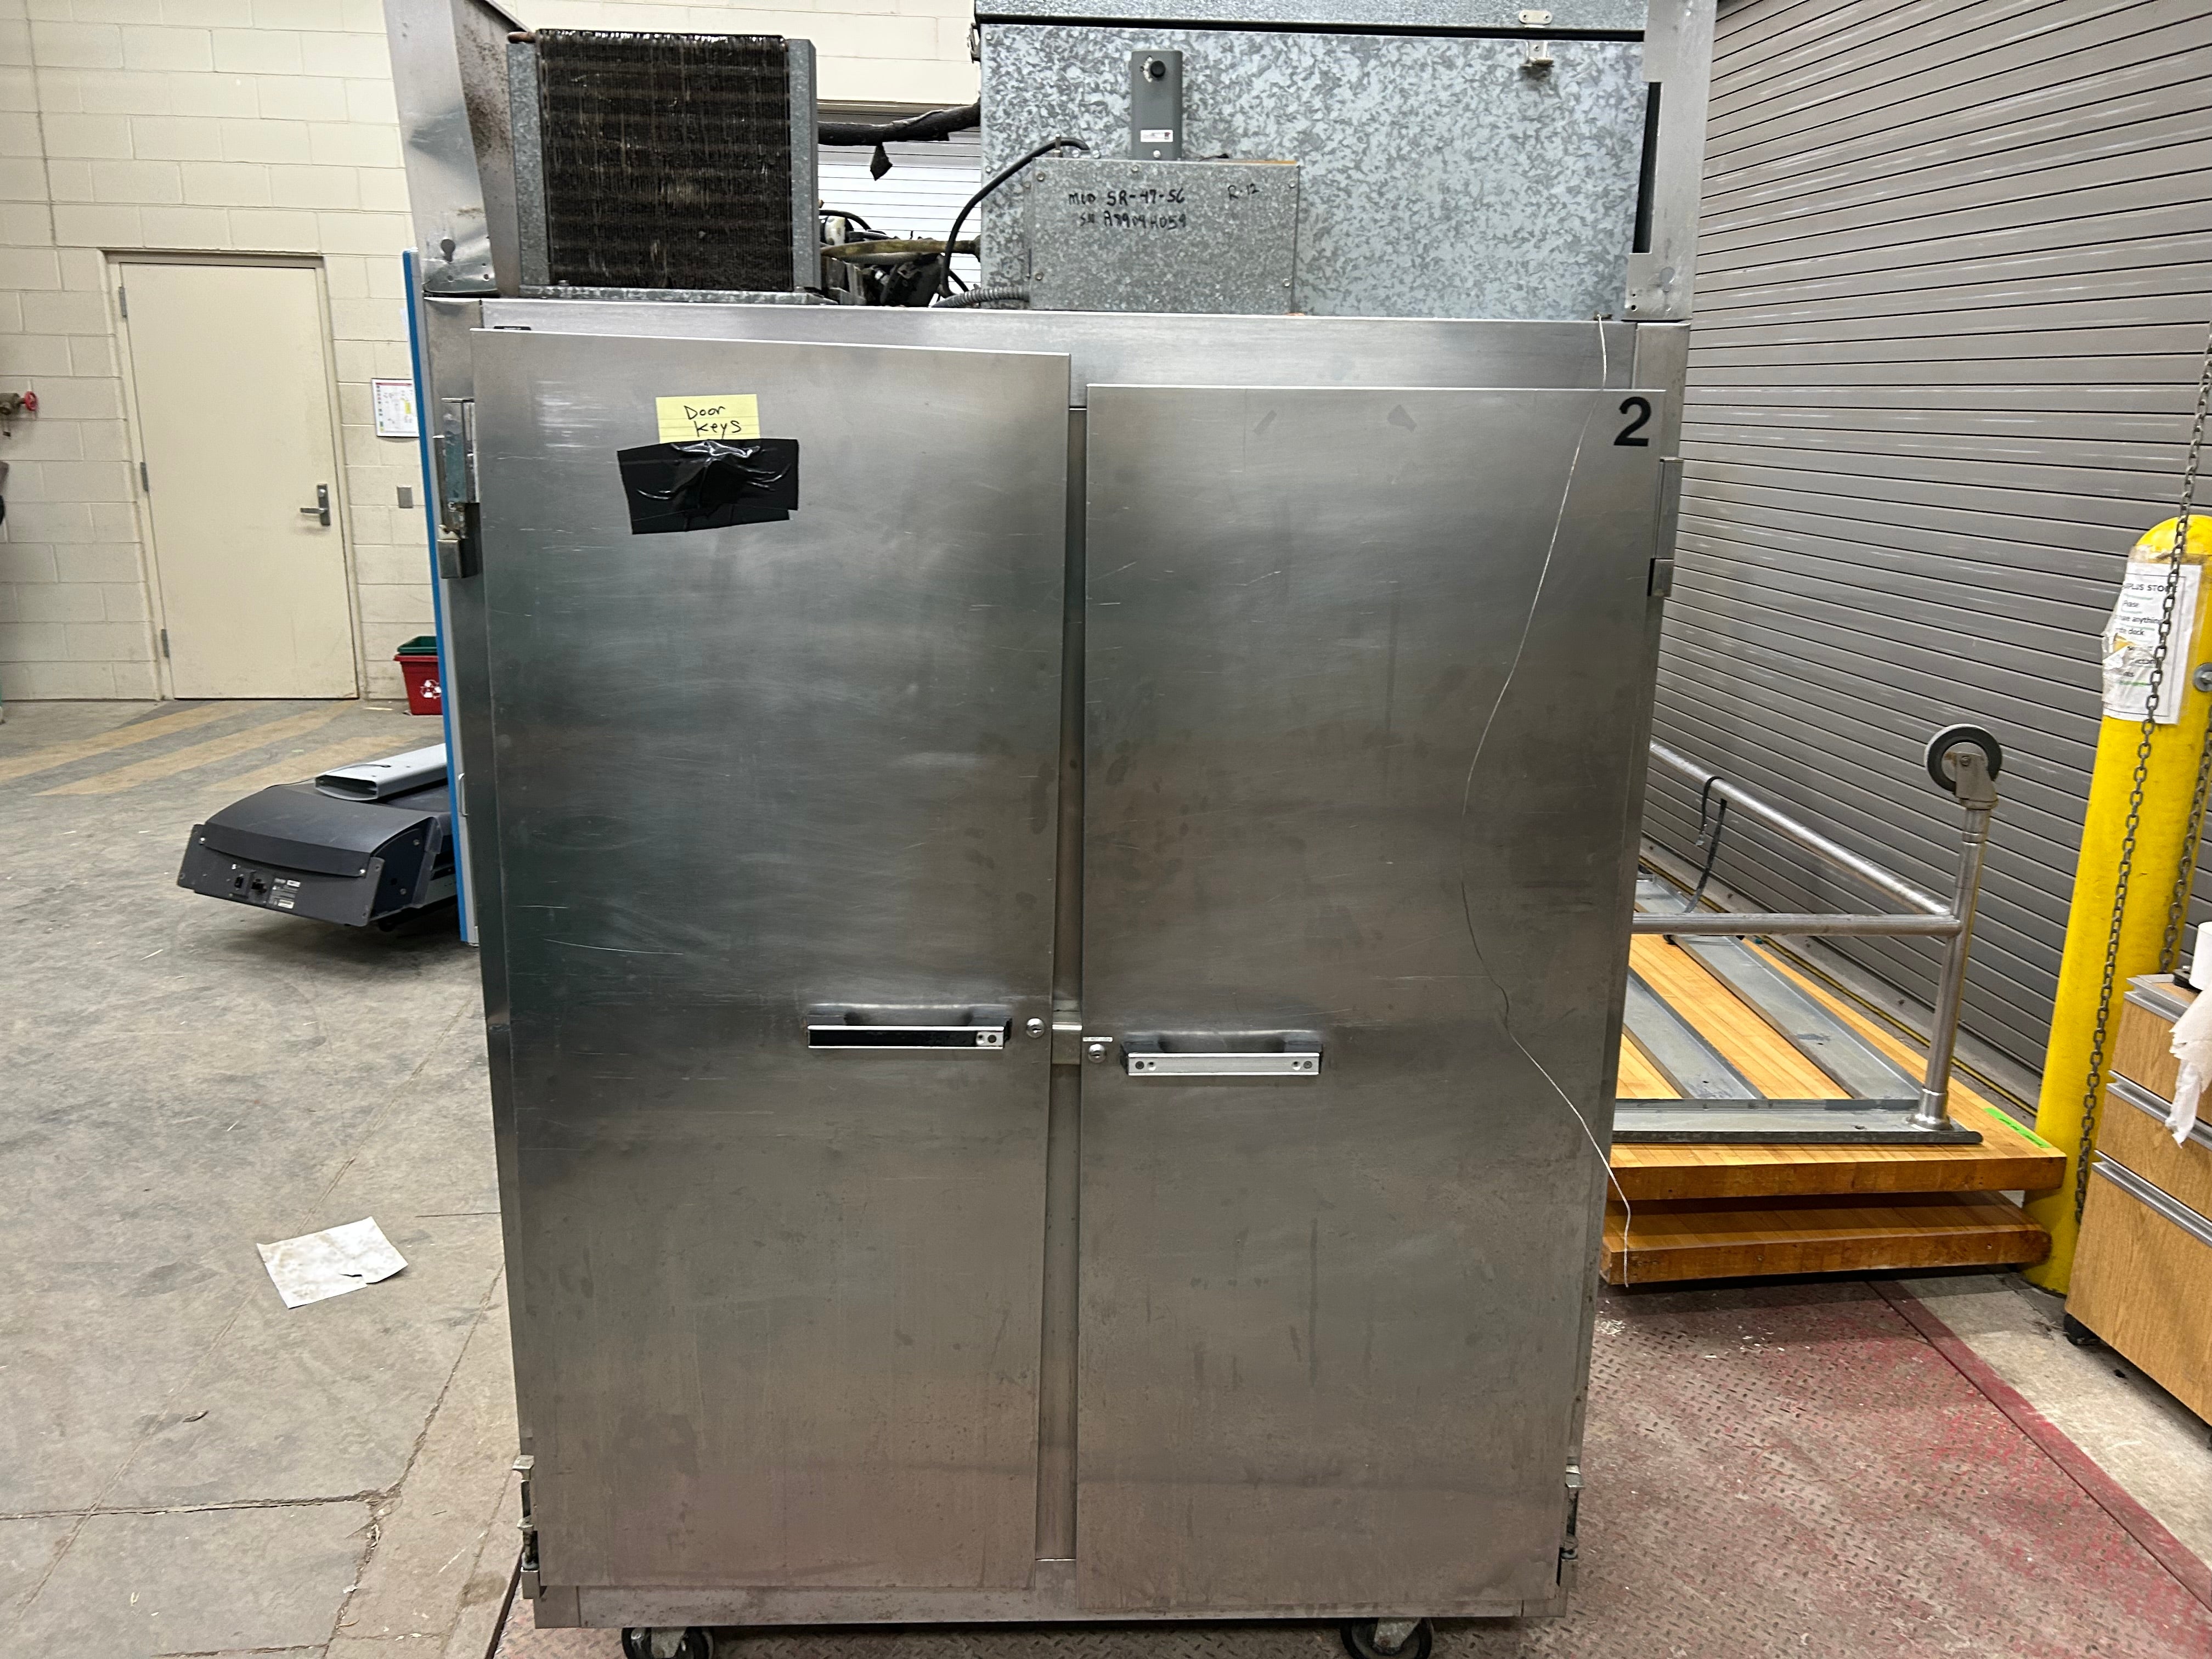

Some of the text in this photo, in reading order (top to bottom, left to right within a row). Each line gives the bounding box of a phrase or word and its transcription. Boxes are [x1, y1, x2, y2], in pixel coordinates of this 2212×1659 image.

[1228, 183, 1260, 201] R-12
[684, 405, 725, 420] Door
[1613, 396, 1651, 447] 2
